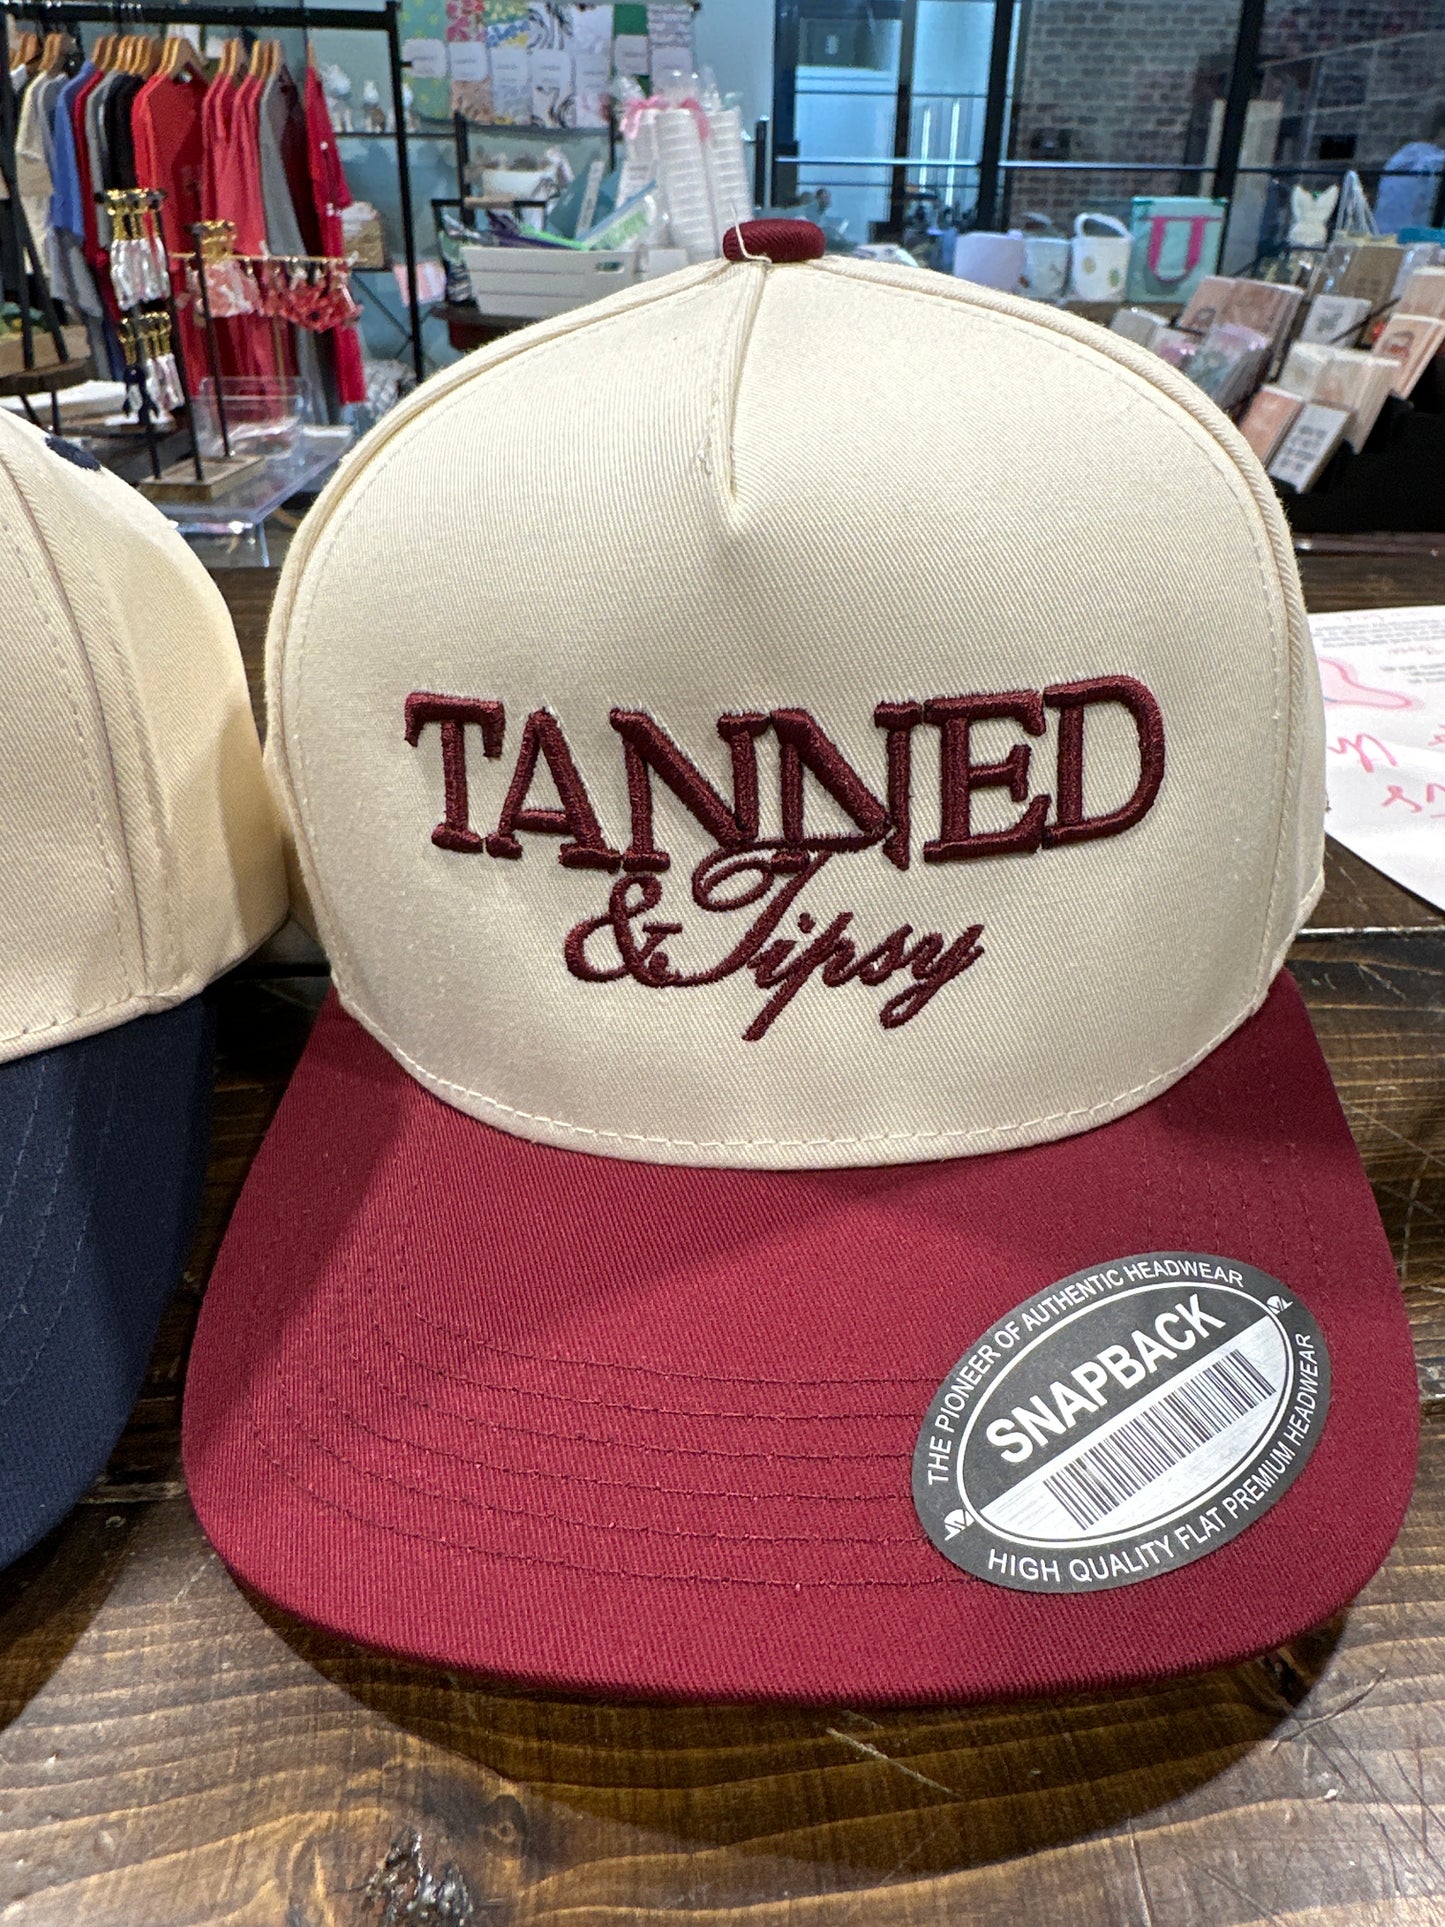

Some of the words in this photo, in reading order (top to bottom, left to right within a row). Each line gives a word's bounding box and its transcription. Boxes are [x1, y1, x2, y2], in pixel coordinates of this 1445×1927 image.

[403, 674, 1166, 872] TANNED
[564, 873, 682, 988] &
[676, 836, 986, 1042] Tipsy
[1021, 1268, 1125, 1332] AUTHENTIC
[1123, 1259, 1244, 1288] HEADWEAR
[985, 1293, 1227, 1464] SNAPBACK
[994, 1321, 1021, 1349] OF
[935, 1344, 1002, 1433] PIONEER
[927, 1435, 952, 1486] THE
[988, 1548, 1061, 1583] HIGH
[1069, 1534, 1175, 1583] QUALITY
[1174, 1506, 1227, 1550] FLAT
[1221, 1440, 1297, 1520] PREMIUM
[1283, 1333, 1319, 1447] HEADWEAR
